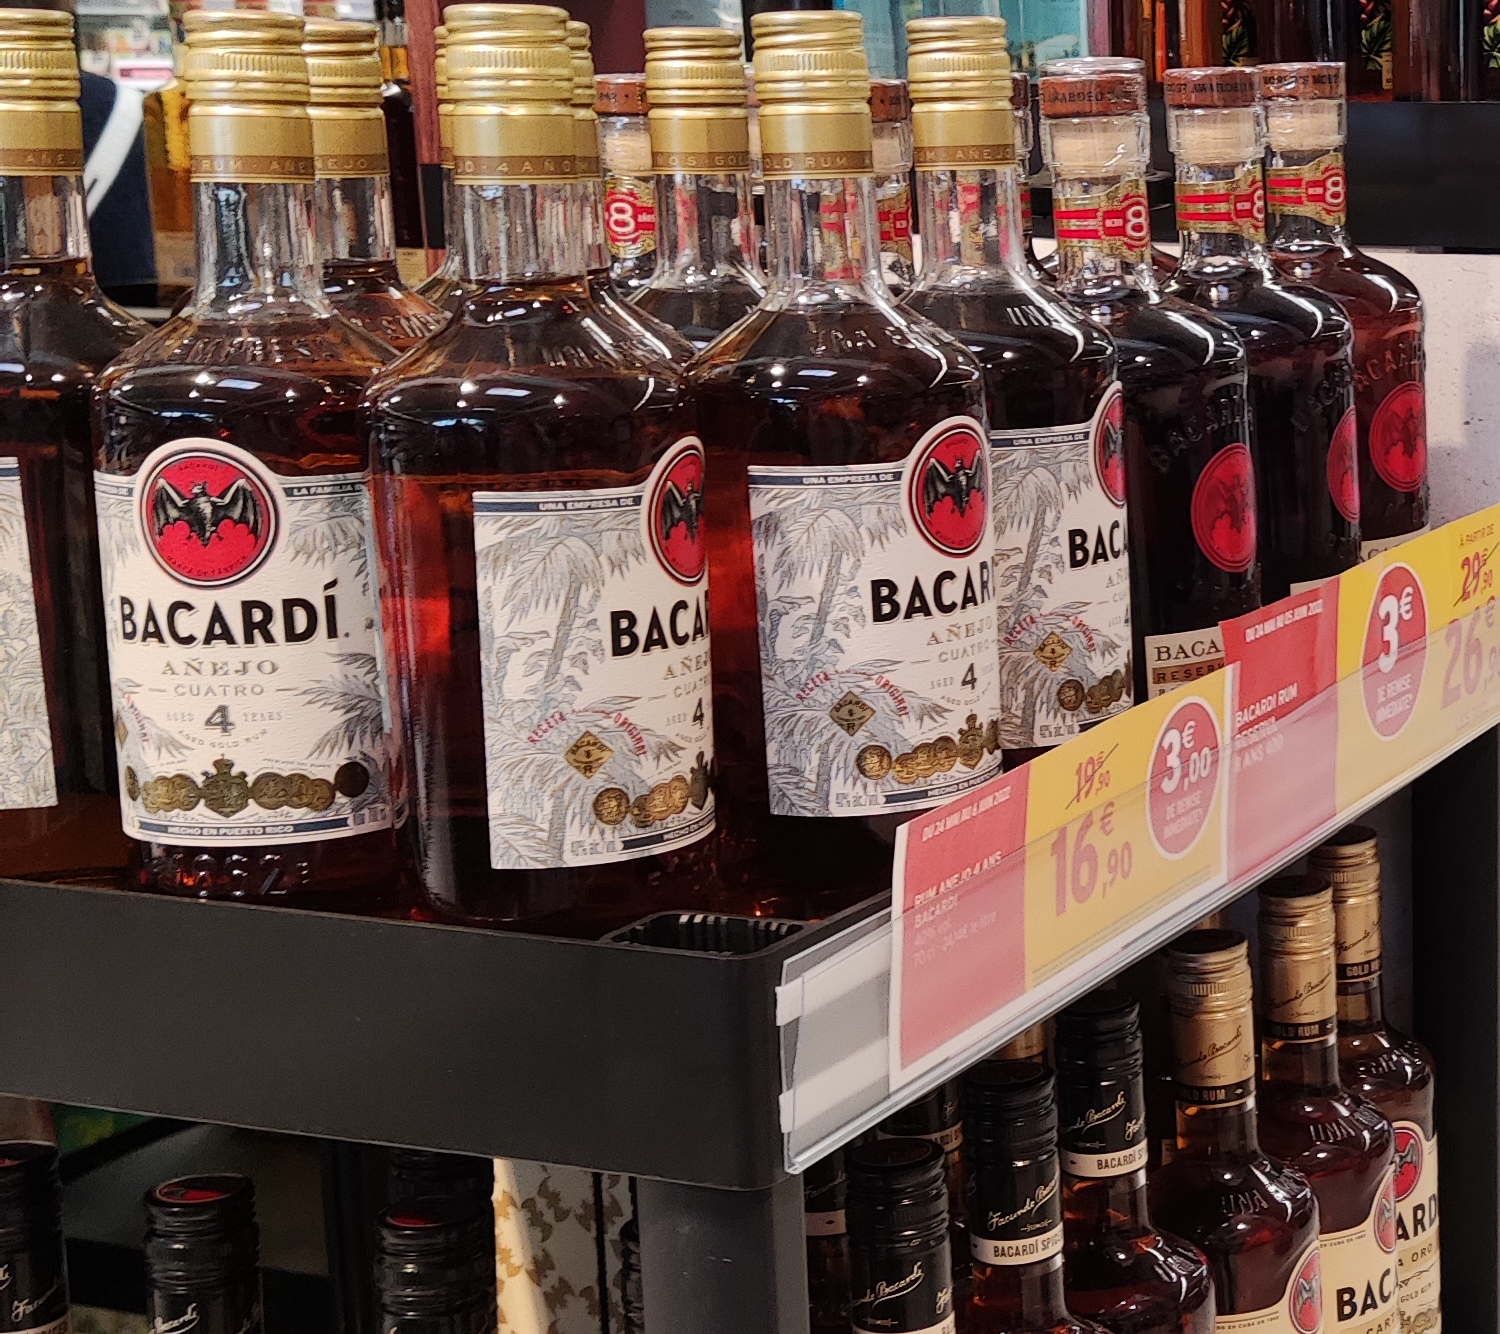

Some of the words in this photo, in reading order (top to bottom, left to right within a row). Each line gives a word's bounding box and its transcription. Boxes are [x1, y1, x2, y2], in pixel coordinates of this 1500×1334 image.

[1324, 175, 1344, 207] 8
[608, 200, 636, 235] 8
[1125, 204, 1147, 239] 8
[870, 553, 998, 624] BACAR
[118, 578, 338, 647] BACARDÍ
[609, 588, 709, 659] BACA
[1154, 637, 1222, 663] BACA
[161, 656, 280, 677] AÑEJO
[960, 662, 978, 691] 4
[1156, 662, 1226, 683] RESERV
[173, 683, 265, 697] CUATRO
[1235, 692, 1278, 727] BACARDI
[1278, 682, 1298, 706] RUM
[204, 704, 235, 737] 4
[691, 697, 706, 727] 4
[1201, 1087, 1228, 1103] RUM
[1097, 1150, 1136, 1171] BACARDÍ
[993, 1238, 1039, 1259] BACARDÍ
